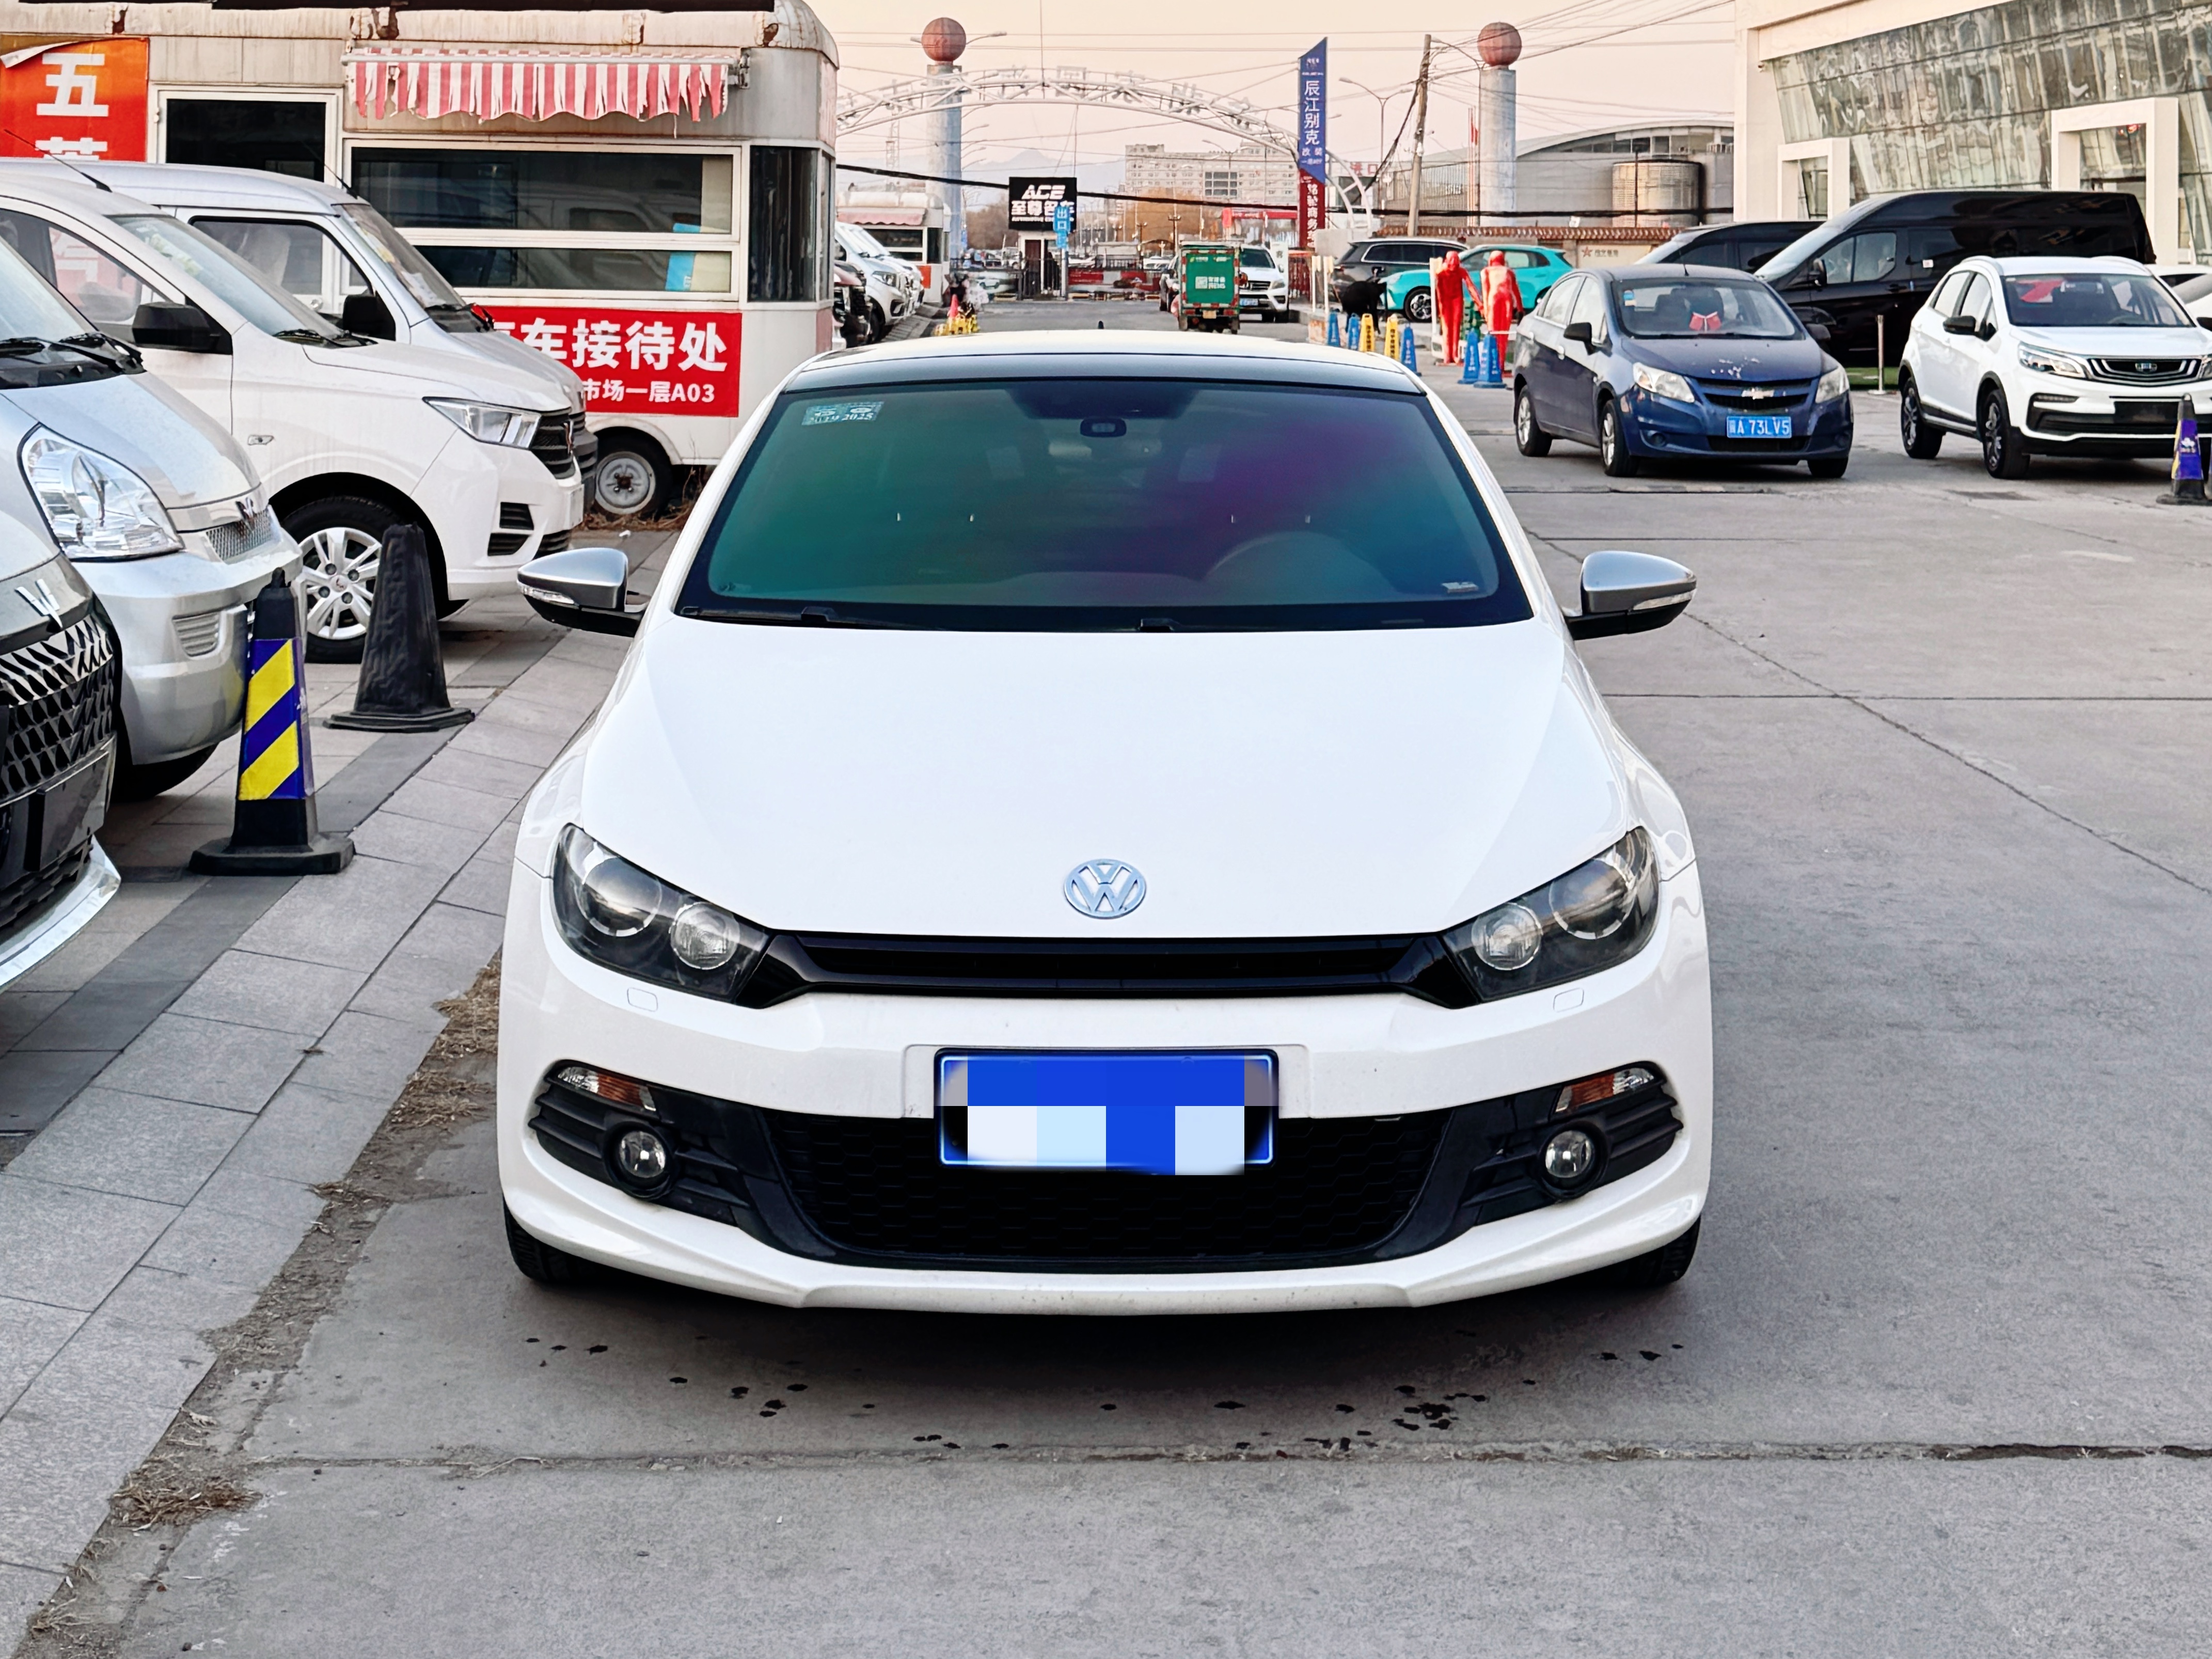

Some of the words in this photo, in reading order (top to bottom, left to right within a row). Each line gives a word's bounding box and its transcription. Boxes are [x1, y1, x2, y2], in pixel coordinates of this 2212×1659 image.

[1304, 80, 1320, 145] 辰江别克
[1021, 185, 1066, 199] ACE
[494, 318, 728, 372] 车接待处
[582, 378, 715, 403] 市场一层A03
